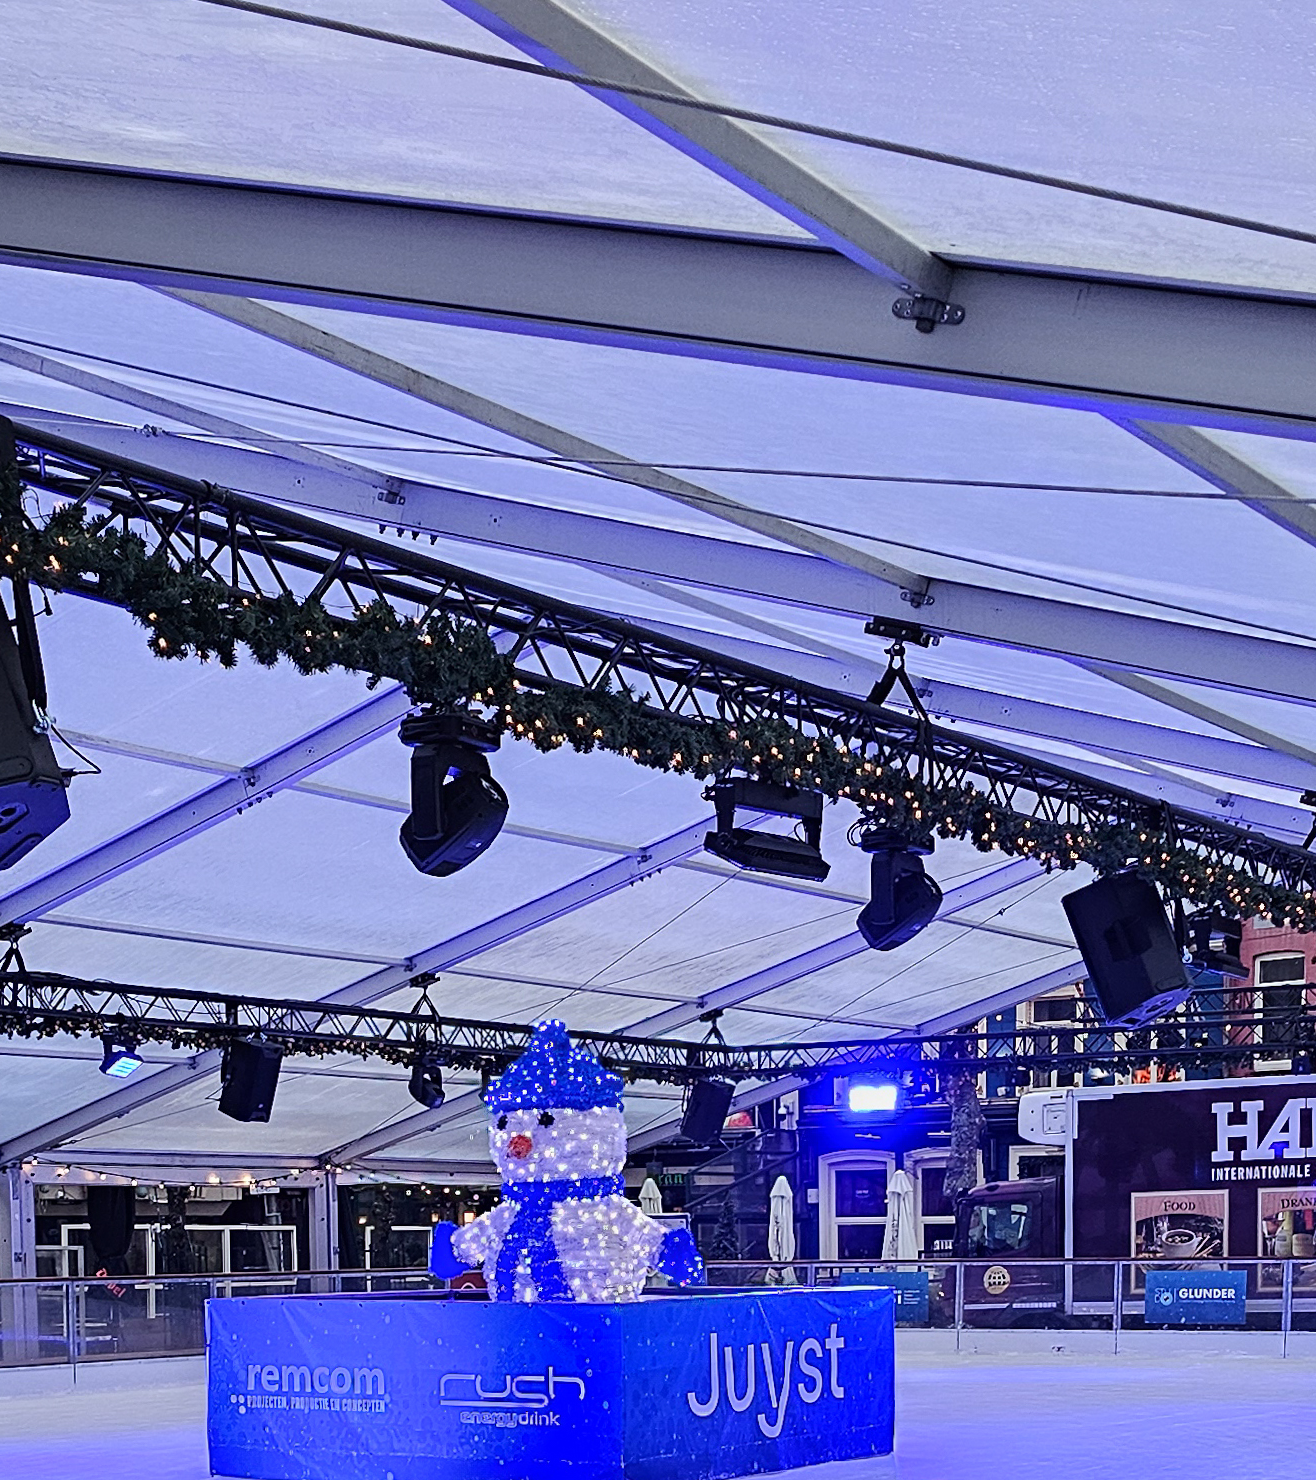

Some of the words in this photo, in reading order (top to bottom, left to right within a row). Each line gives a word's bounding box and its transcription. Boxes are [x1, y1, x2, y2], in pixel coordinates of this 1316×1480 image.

[1211, 1164, 1311, 1182] INTERNATIONALE
[1163, 1200, 1196, 1212] FOOD
[1178, 1288, 1235, 1299] GLUNDER
[246, 1363, 385, 1395] remcom
[687, 1323, 845, 1438] Juyst
